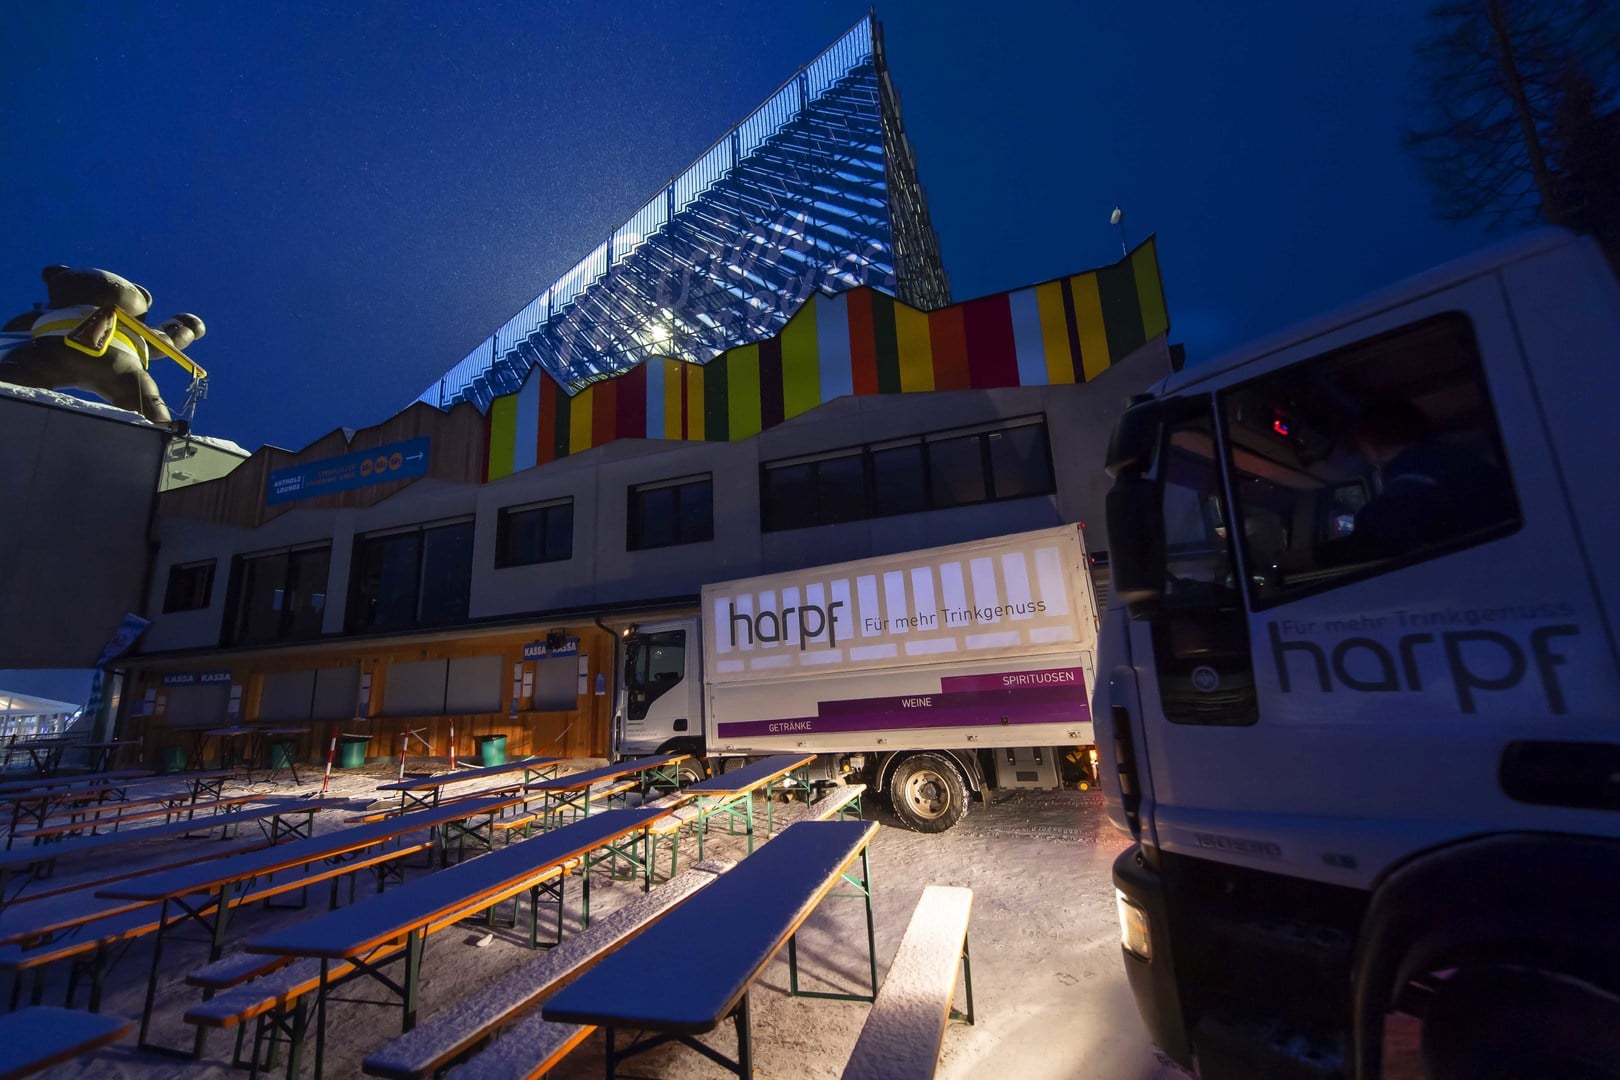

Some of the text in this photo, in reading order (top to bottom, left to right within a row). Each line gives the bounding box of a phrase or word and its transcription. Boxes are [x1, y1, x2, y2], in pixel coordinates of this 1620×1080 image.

[276, 484, 300, 494] LOUNGE
[864, 599, 1047, 632] Für mehr Trinkgenuss
[1325, 613, 1385, 632] mehr
[729, 600, 844, 651] harpf
[524, 646, 547, 657] KASSA
[1267, 620, 1581, 715] harpf
[164, 674, 194, 683] KASSA
[201, 673, 231, 682] KASSA
[1002, 671, 1075, 687] SPIRITUOSEN
[901, 697, 932, 709] WEINE
[768, 719, 812, 733] GETRÄNKE
